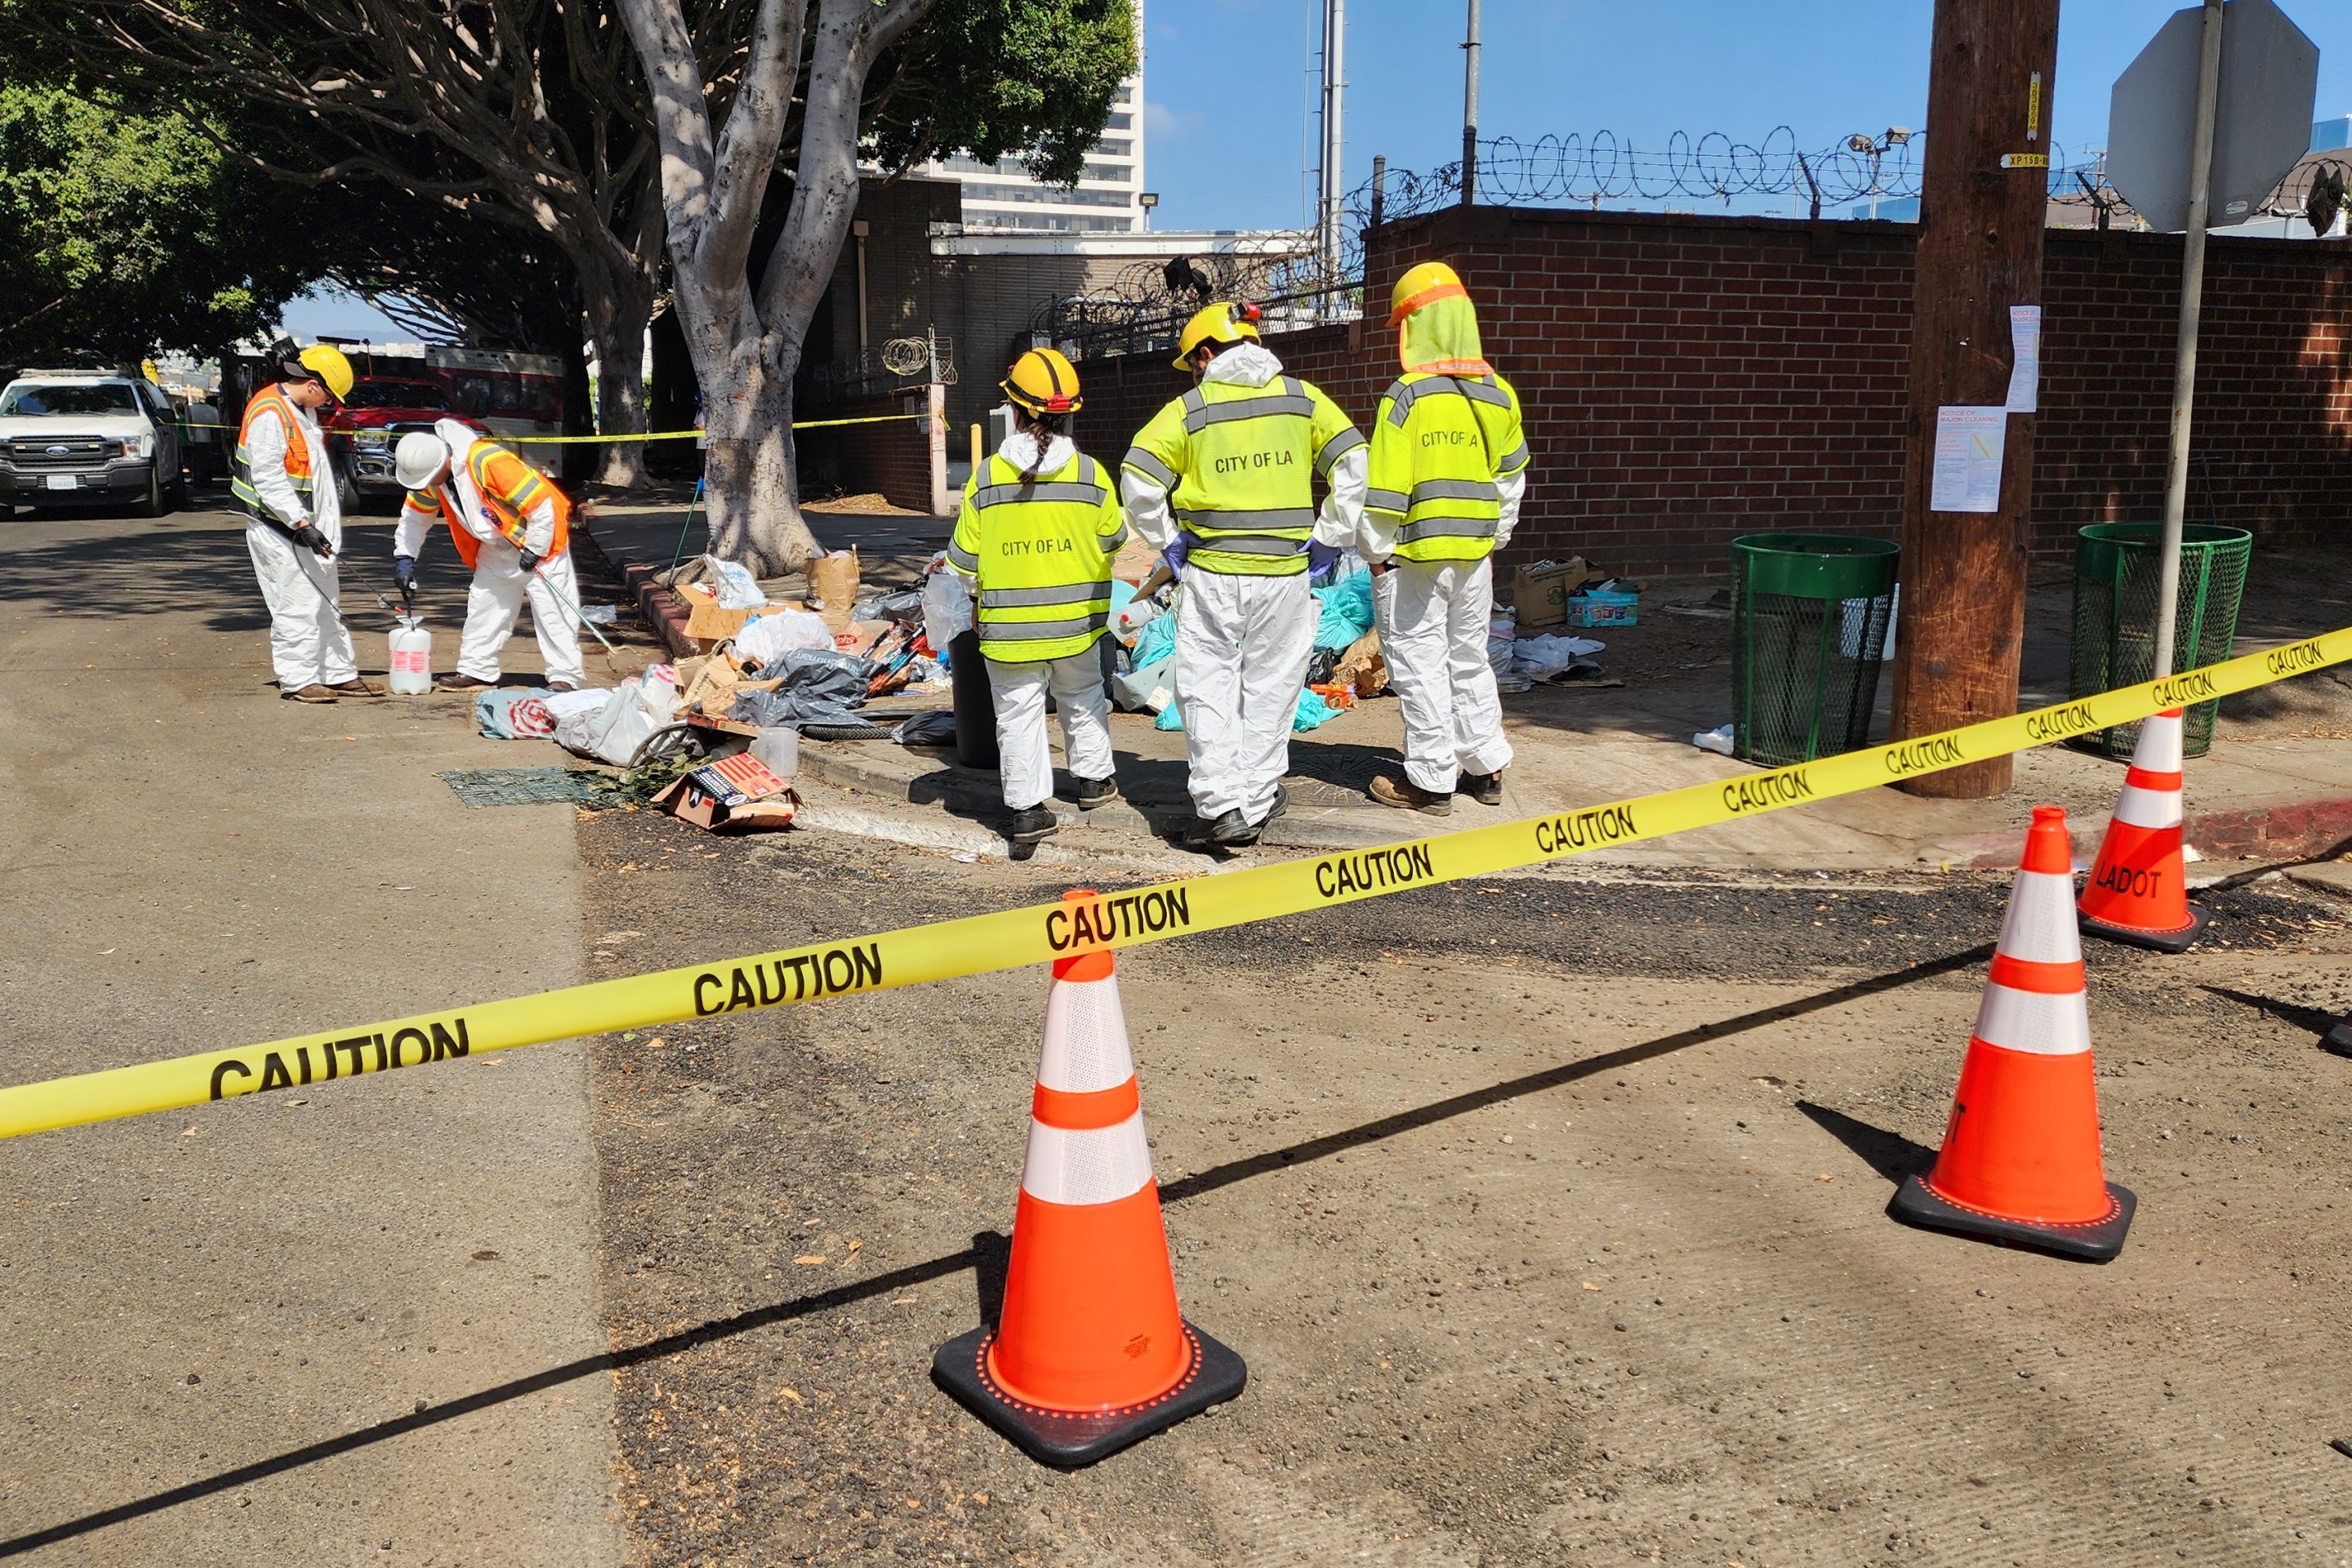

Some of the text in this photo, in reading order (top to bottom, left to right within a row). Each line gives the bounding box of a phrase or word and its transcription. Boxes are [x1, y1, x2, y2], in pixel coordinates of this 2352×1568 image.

[1422, 430, 1478, 448] CITY OF A
[1215, 450, 1294, 474] CITY OF LA
[1002, 538, 1072, 556] CITY OF LA
[210, 640, 2325, 1102] CAUTION CAUTION CAUTION CAUTION CAUTION CAUTION CAUTION CAUTION CAUTION CAUTION
[2096, 860, 2163, 899] LADOT
